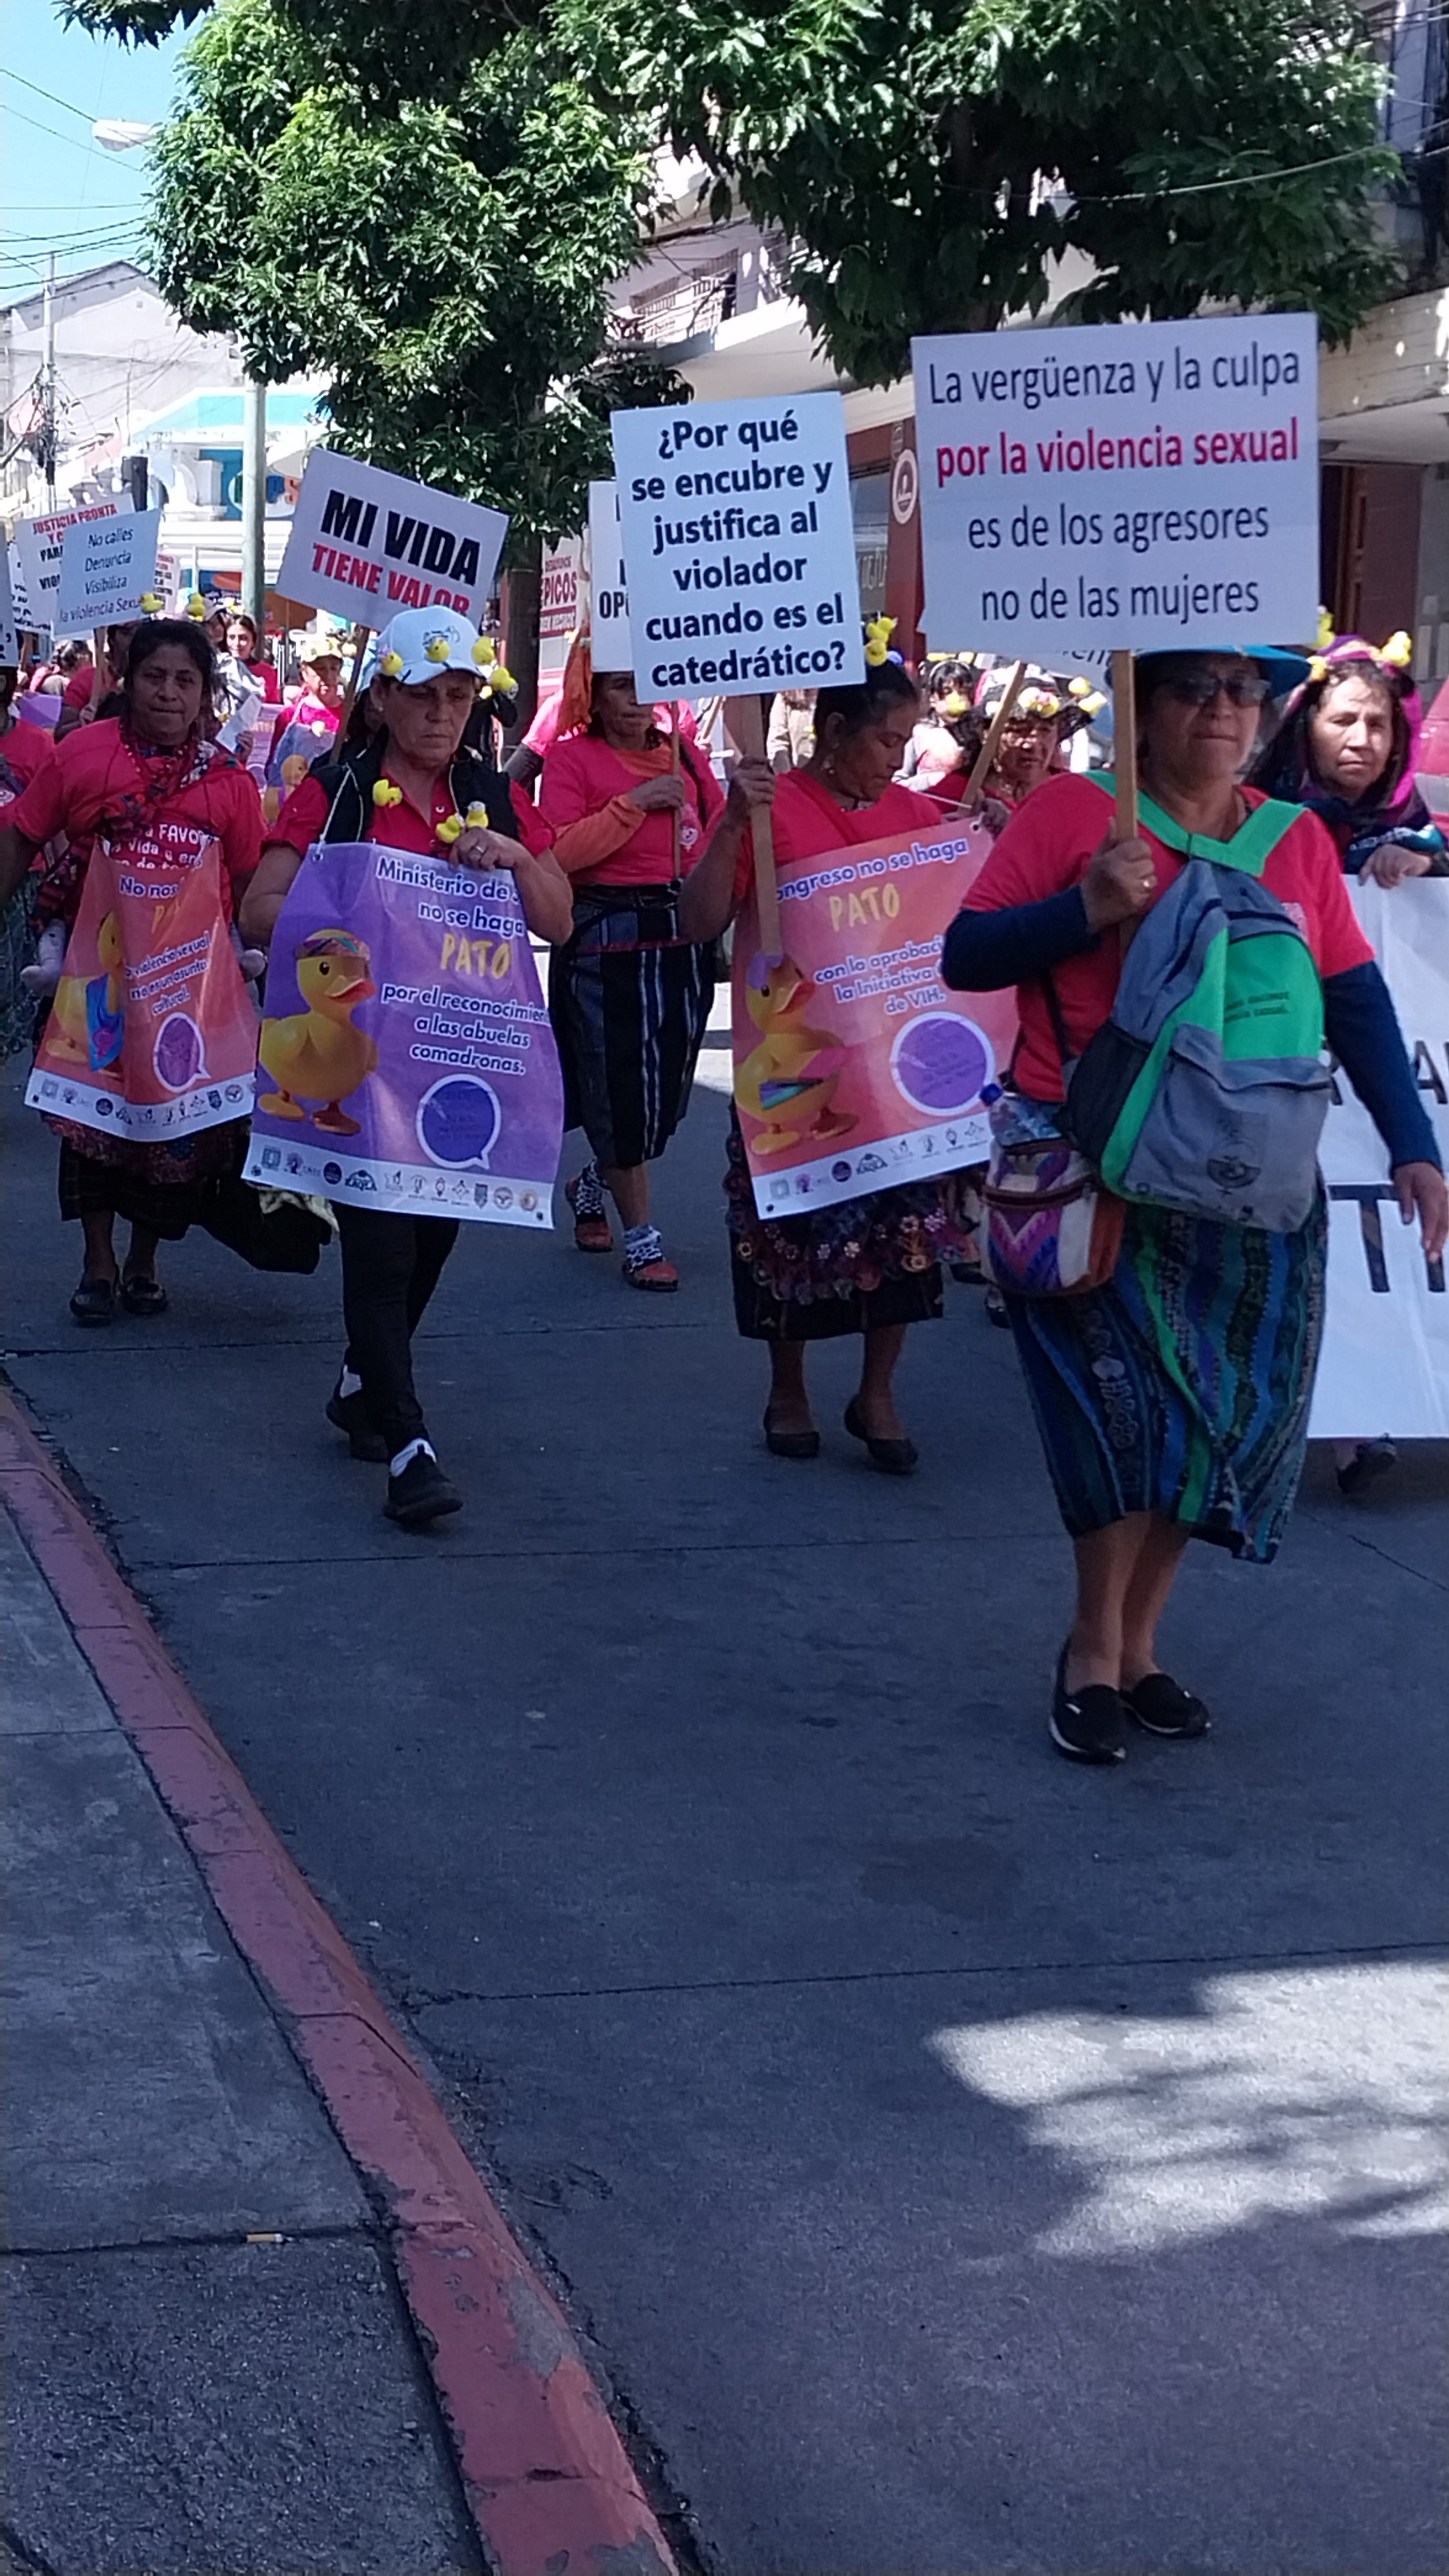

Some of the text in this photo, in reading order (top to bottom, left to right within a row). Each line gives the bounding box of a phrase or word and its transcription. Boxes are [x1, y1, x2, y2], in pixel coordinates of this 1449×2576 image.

[929, 341, 1300, 409] La vergüenza y la culpa
[658, 409, 798, 459] ¿Por qué
[937, 417, 1298, 488] por la violencia sexual
[632, 460, 833, 501] se encubre y
[33, 503, 118, 535] JUSTICIA PRONTA
[88, 528, 134, 548] No calles
[320, 489, 481, 586] MI VIDA
[653, 508, 780, 555] justifica
[791, 502, 818, 533] al
[969, 503, 1269, 553] es de los agresores
[85, 550, 132, 571] Denuncia
[312, 542, 471, 617] TIENE VALOR
[673, 553, 807, 591] violador
[85, 576, 128, 595] Visibiliza
[544, 571, 577, 605] PICOS
[982, 574, 1259, 626] no de las mujeres
[60, 597, 140, 622] la violencia Sexu
[646, 593, 844, 640] cuando es el
[652, 641, 846, 687] catedrático?
[120, 875, 145, 895] No
[377, 858, 475, 895] Ministerio
[482, 879, 508, 899] de
[777, 841, 967, 900] ongreso no se haga
[420, 903, 523, 938] no se haga
[829, 883, 900, 932] PATO
[440, 932, 511, 979] PATO
[815, 966, 846, 983] con
[848, 957, 865, 972] la
[871, 936, 944, 968] aprobaci
[132, 986, 148, 999] no
[383, 984, 550, 1023] por el reconocimien
[835, 969, 933, 1001] la Iniciativa
[886, 987, 945, 1013] de VIH.
[416, 1015, 529, 1047] a las abuelas
[412, 1045, 524, 1073] comadronas.
